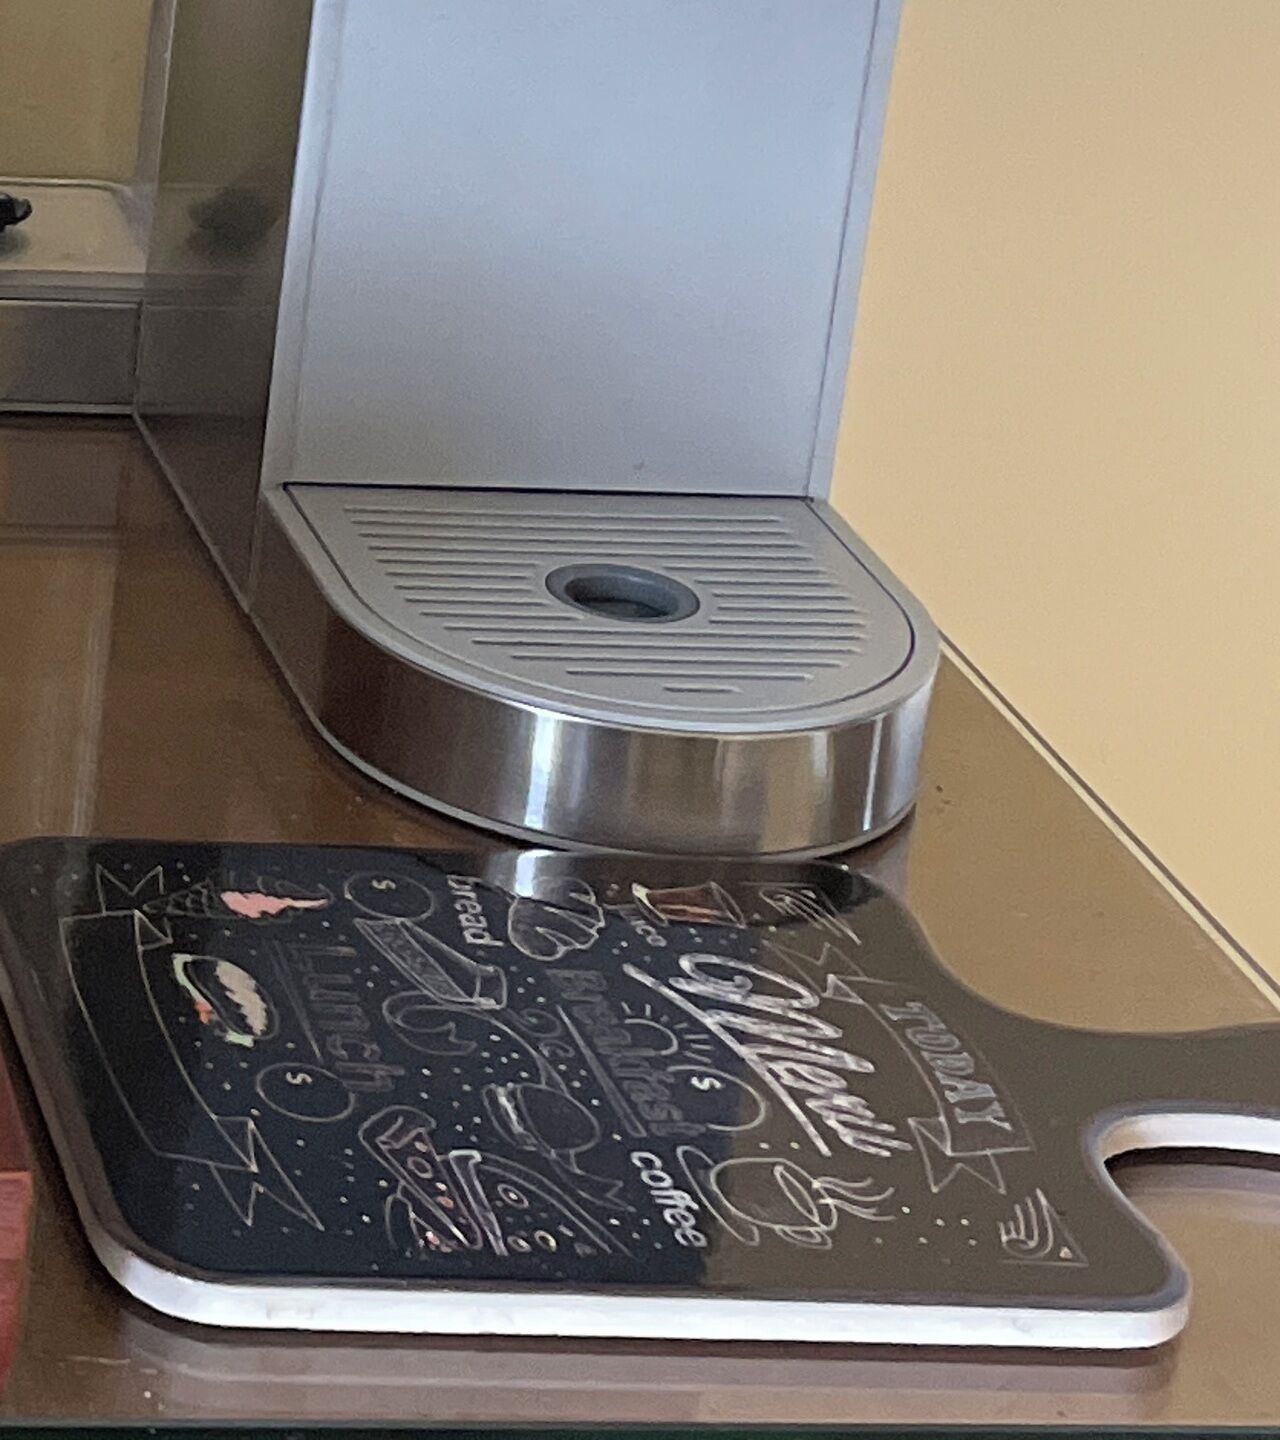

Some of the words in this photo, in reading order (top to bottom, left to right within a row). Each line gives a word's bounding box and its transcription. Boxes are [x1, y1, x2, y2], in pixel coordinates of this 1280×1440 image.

[447, 874, 504, 946] bread
[668, 952, 914, 1157] Menu
[880, 1001, 1013, 1131] TODAY
[631, 1151, 708, 1249] coffee
